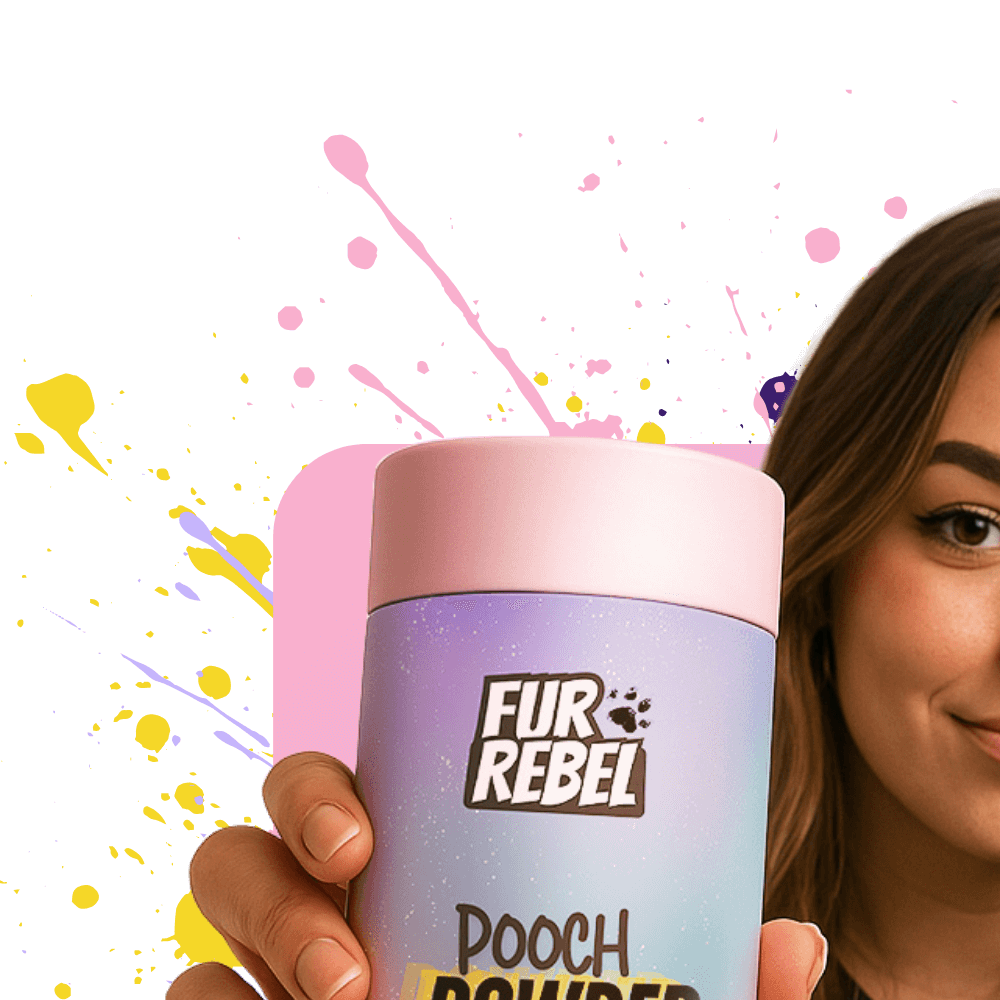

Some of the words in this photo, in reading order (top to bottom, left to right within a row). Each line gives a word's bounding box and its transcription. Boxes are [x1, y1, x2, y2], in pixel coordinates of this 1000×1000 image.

[480, 678, 599, 740] FUR
[471, 738, 640, 808] REBEL
[455, 903, 629, 978] POOCH
